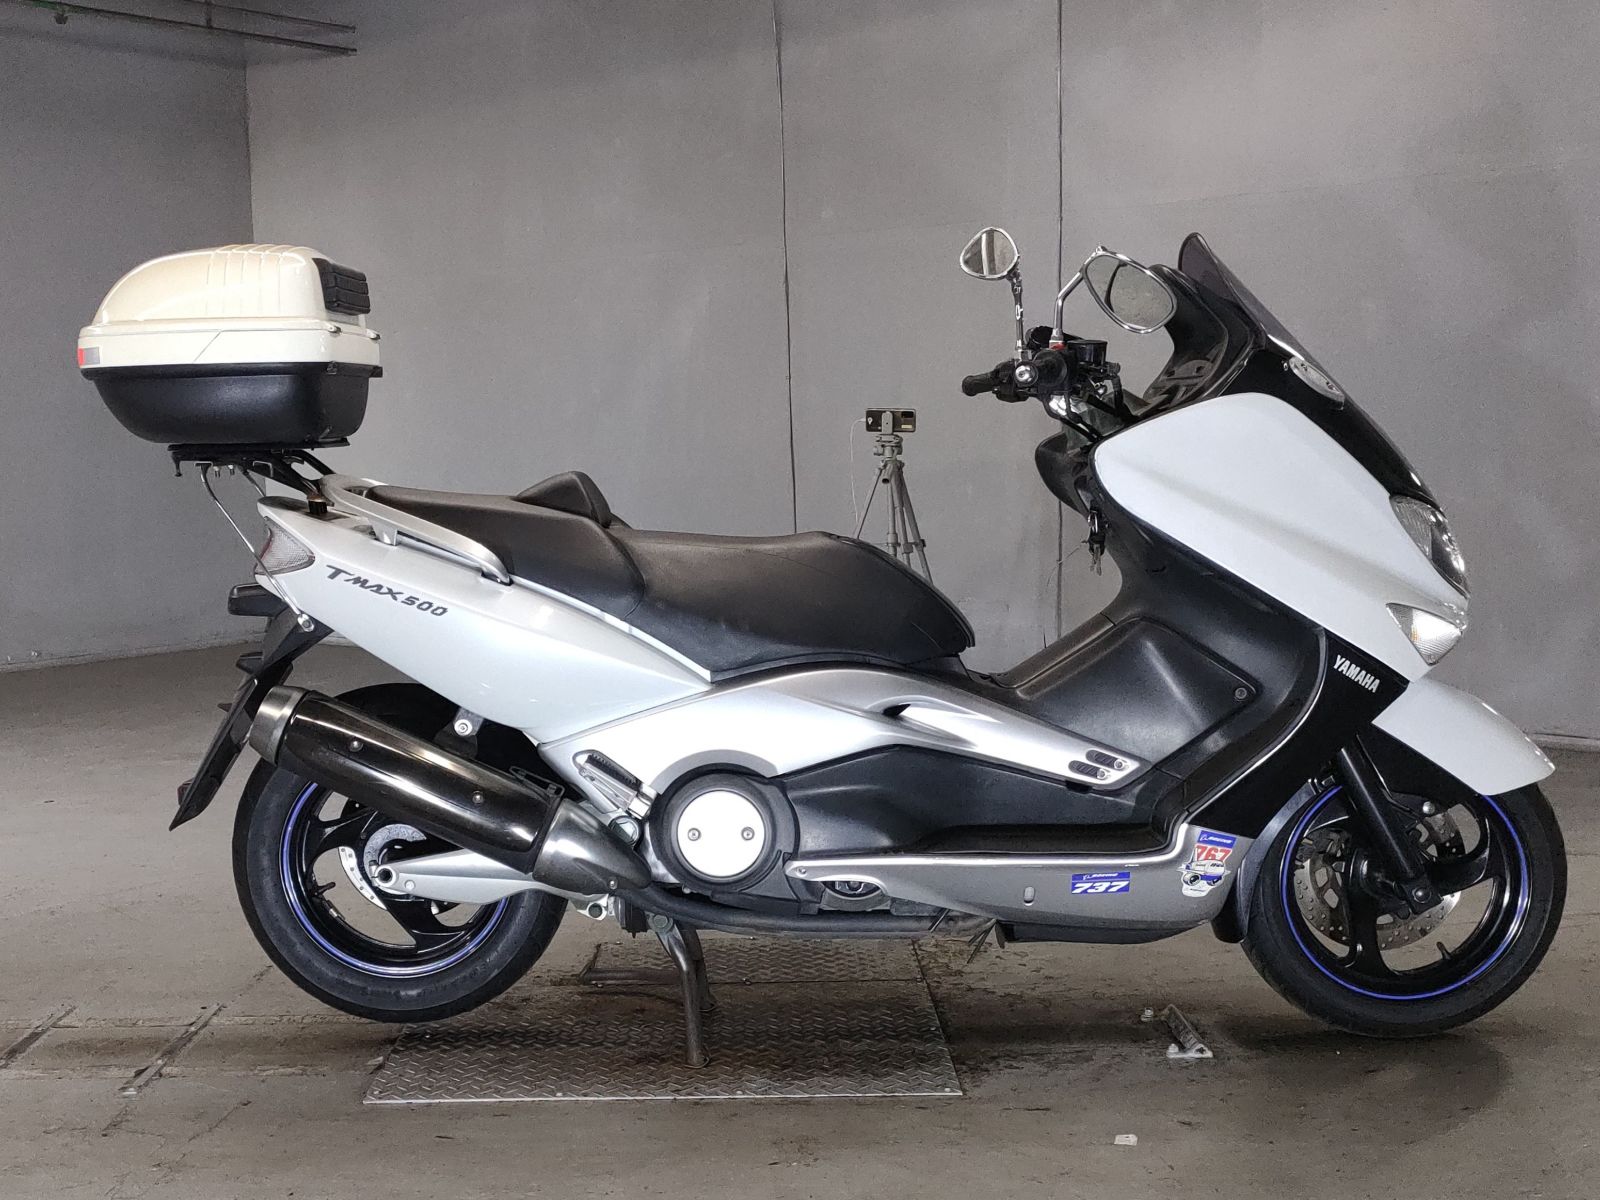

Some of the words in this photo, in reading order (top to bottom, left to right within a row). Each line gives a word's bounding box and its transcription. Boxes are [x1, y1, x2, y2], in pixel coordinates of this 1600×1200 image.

[1333, 654, 1380, 693] YAMAHA
[1195, 844, 1232, 862] 767
[1071, 881, 1130, 894] 737
